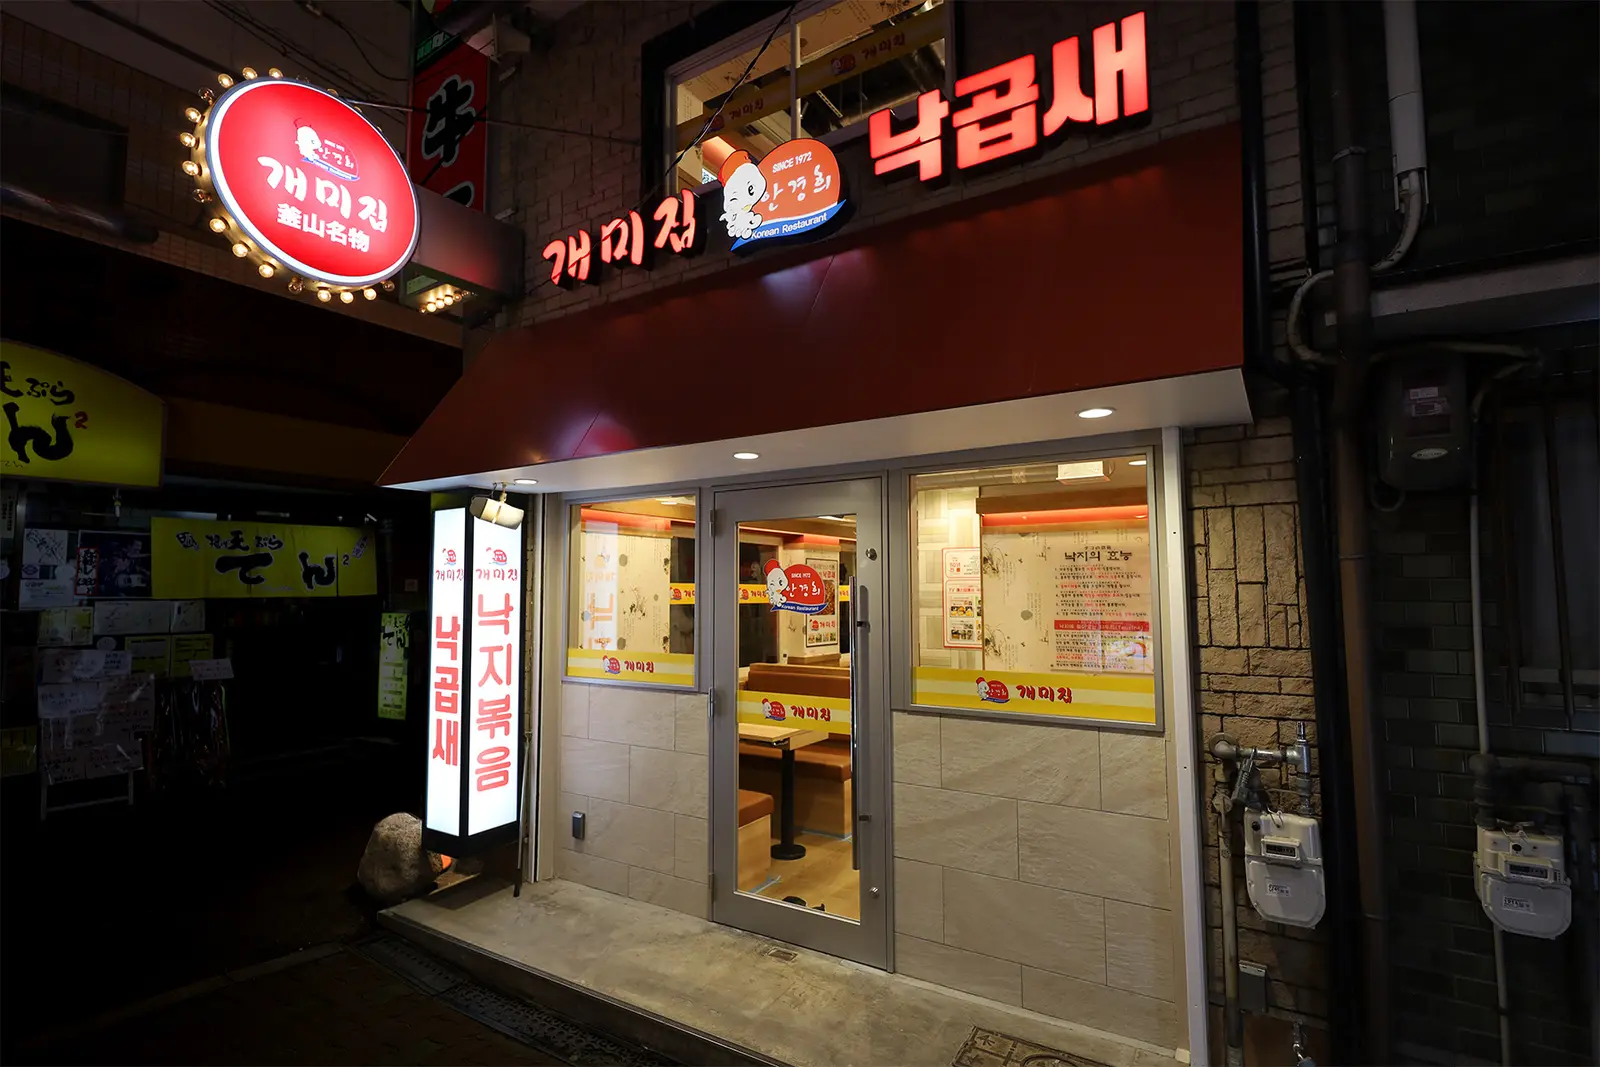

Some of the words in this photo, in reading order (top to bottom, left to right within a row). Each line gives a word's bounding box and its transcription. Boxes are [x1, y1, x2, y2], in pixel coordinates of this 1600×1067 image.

[868, 10, 1150, 183] 낙곱새
[771, 157, 794, 175] SINCE
[795, 151, 813, 167] 1972
[257, 155, 388, 233] 개미집
[277, 203, 370, 253] 釜山名物
[542, 188, 696, 286] 개미집
[751, 226, 780, 241] Korean
[781, 212, 828, 234] Restaurant
[1065, 550, 1101, 563] 낙지의
[1107, 550, 1132, 562] 효능
[476, 568, 518, 582] 개미집
[624, 660, 654, 673] 개미집
[432, 616, 460, 766] 낙곱새
[474, 593, 514, 792] 낙지볶음
[1016, 684, 1073, 704] 개미집
[790, 705, 831, 722] 개미집
